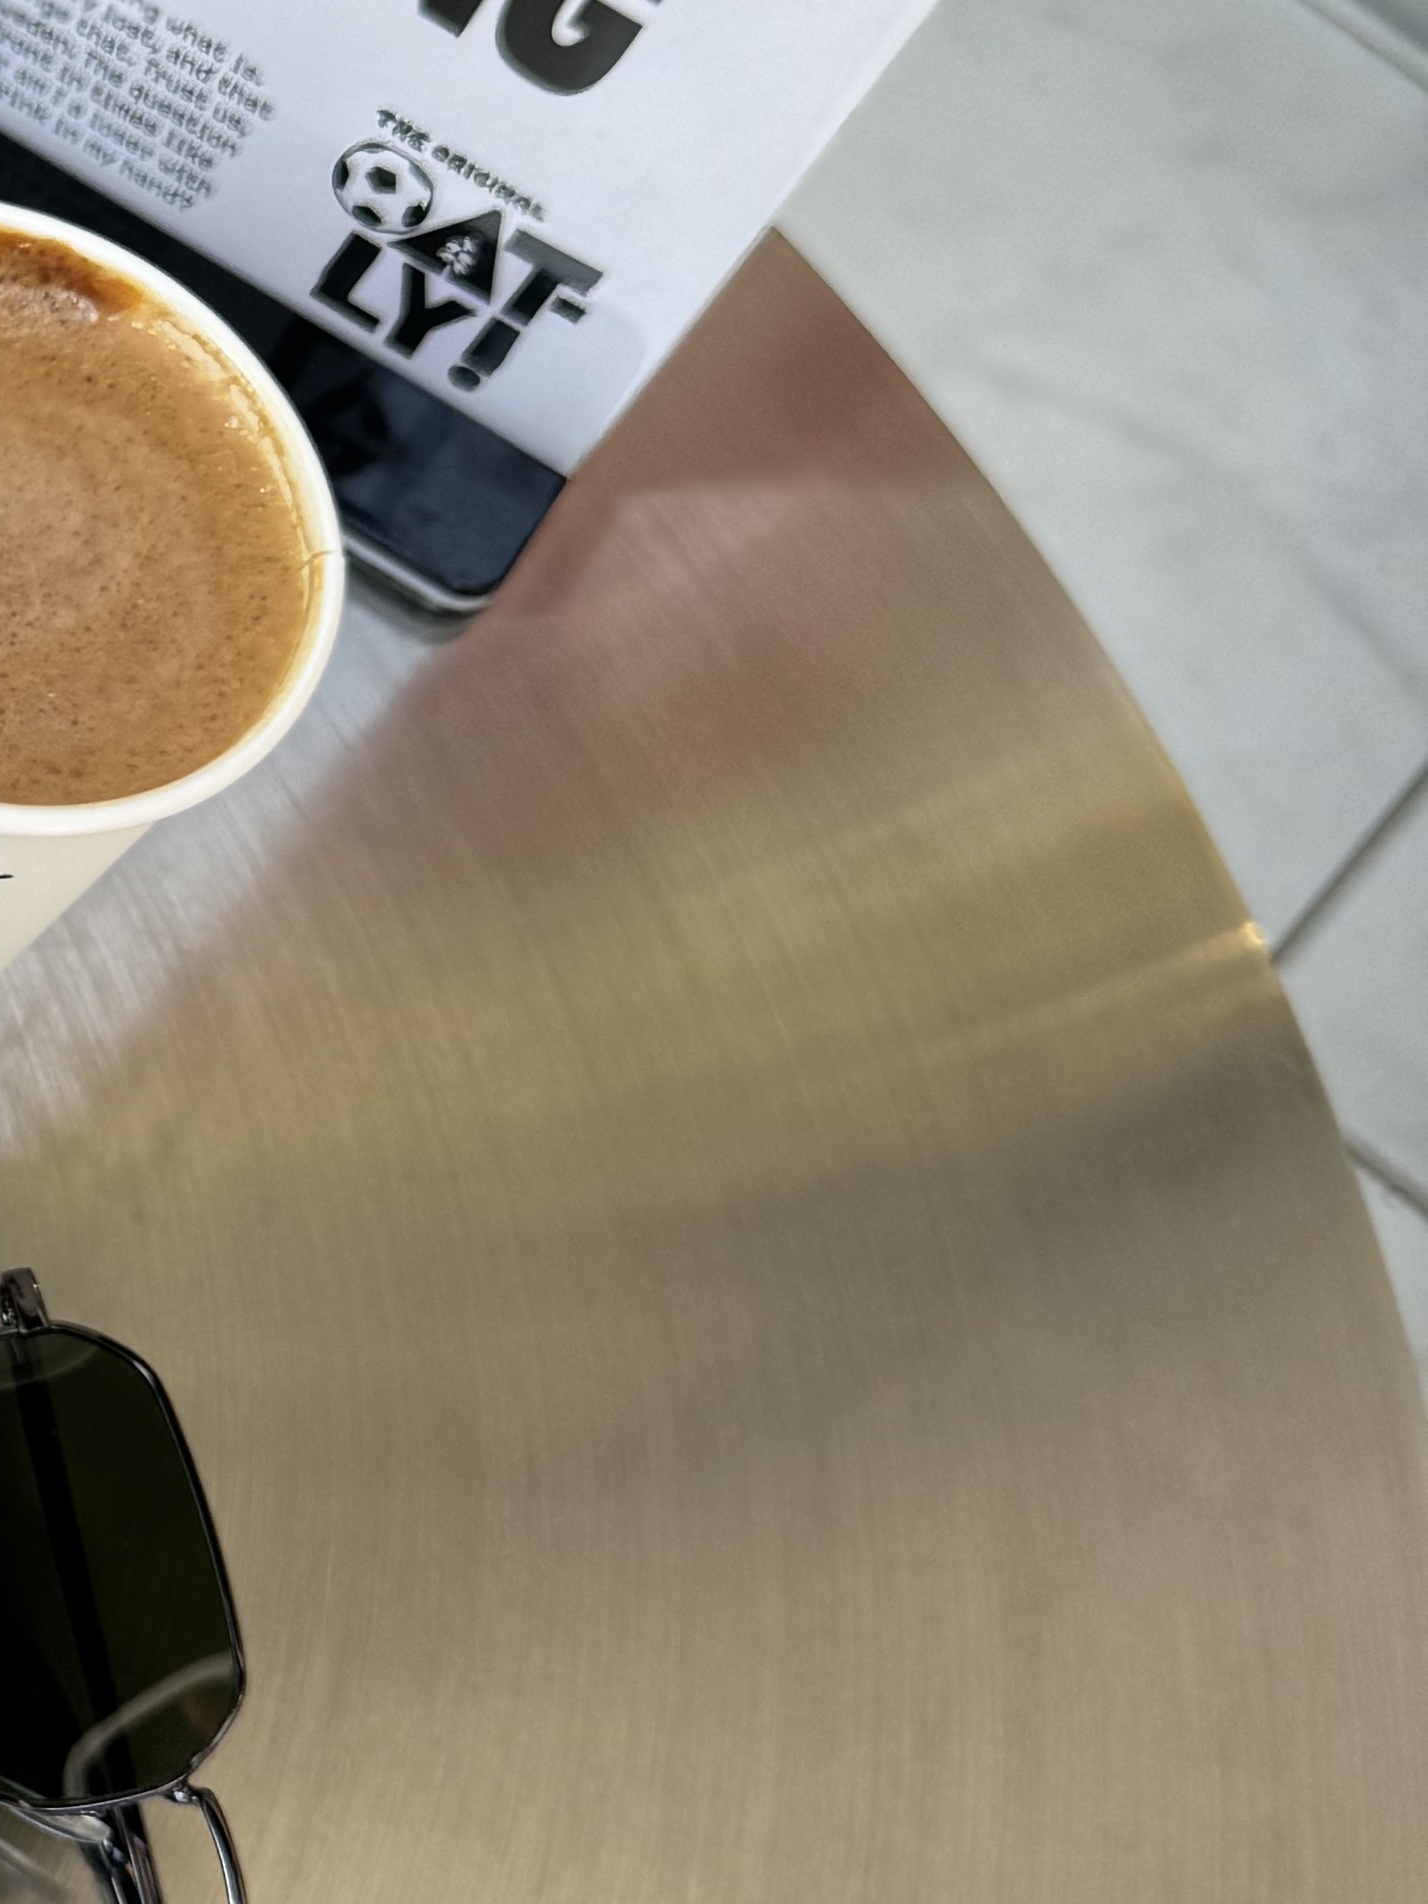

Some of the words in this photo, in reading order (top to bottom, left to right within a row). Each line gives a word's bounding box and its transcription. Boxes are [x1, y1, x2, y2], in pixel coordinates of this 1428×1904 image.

[76, 10, 136, 66] that.
[143, 52, 211, 111] Trust
[212, 102, 249, 138] us,
[102, 4, 163, 53] lost,
[165, 46, 216, 83] and
[217, 73, 273, 120] that
[165, 16, 227, 63] what
[229, 53, 262, 86] is.
[84, 48, 127, 88] The
[128, 81, 240, 156] question
[89, 110, 155, 160] loser
[90, 81, 160, 137] times
[162, 128, 215, 170] like
[120, 159, 194, 209] hand?
[377, 109, 430, 152] THE
[432, 146, 544, 222] ORIGINAL
